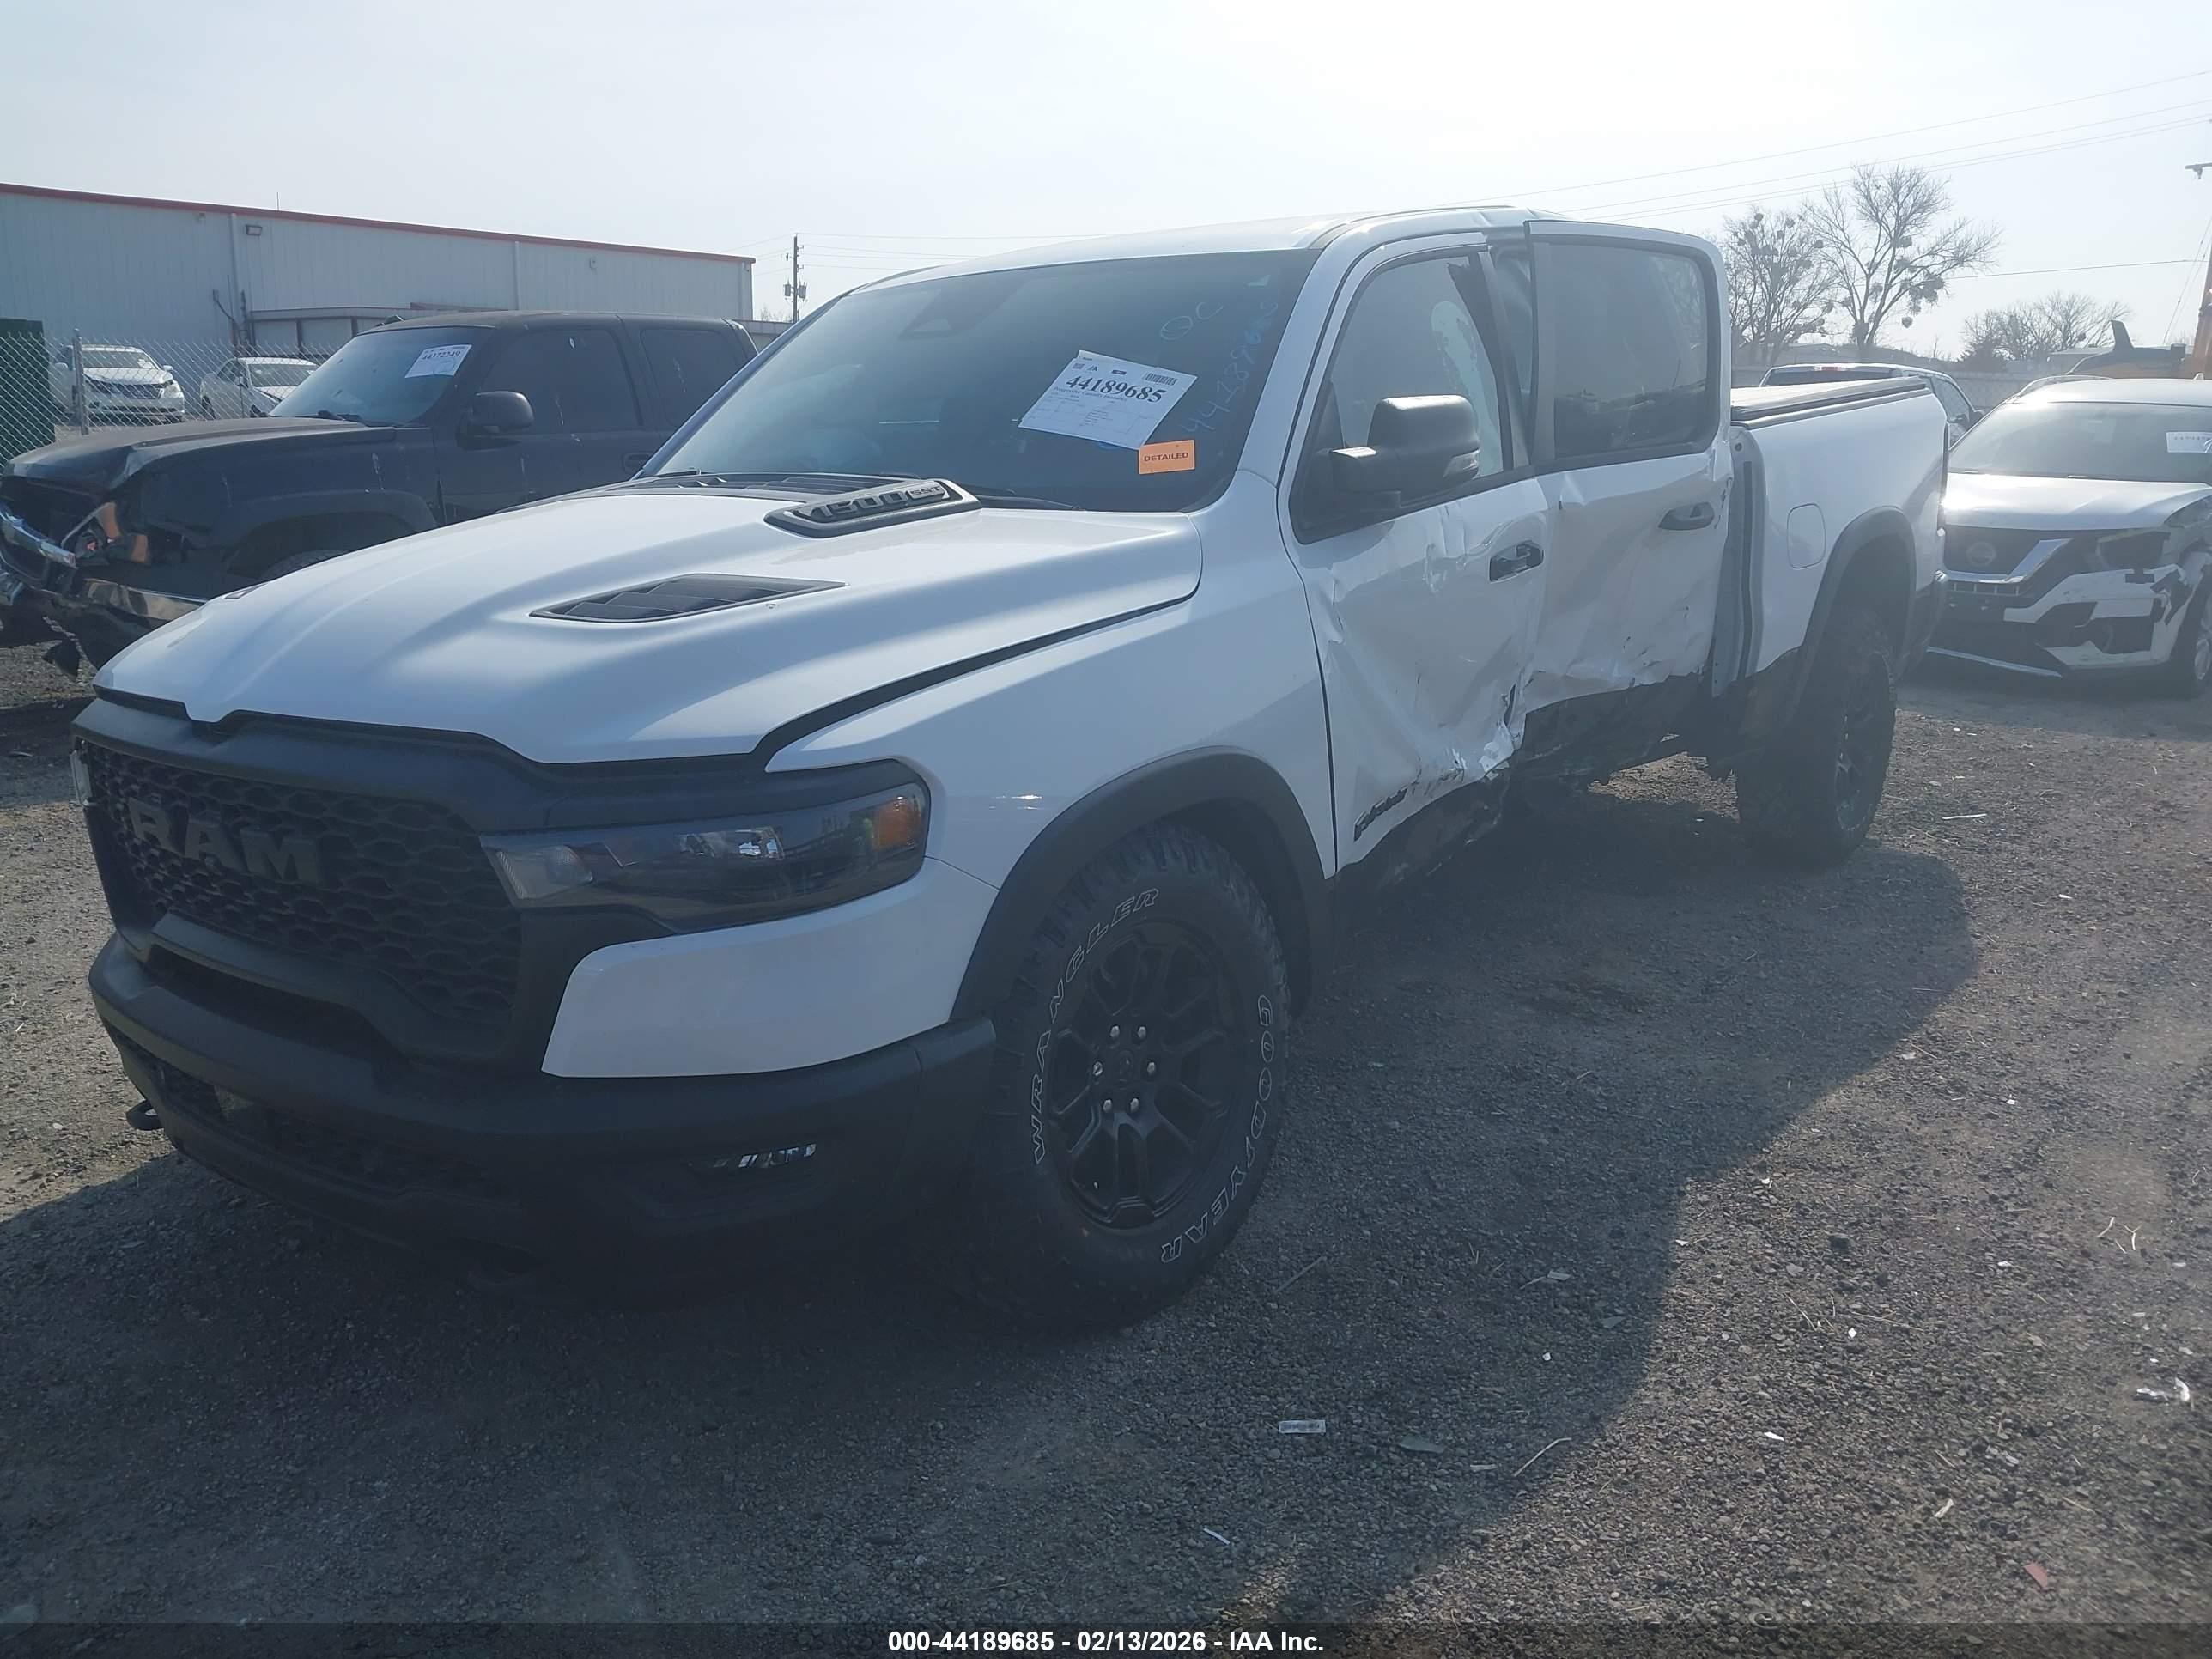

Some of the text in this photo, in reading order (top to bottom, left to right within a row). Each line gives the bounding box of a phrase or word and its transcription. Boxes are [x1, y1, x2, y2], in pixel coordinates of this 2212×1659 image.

[1066, 374, 1167, 403] 44189685
[1144, 451, 1189, 463] DETAILED
[128, 797, 321, 883] RAM
[1031, 888, 1160, 1165] WRANGLER
[1160, 994, 1274, 1264] GOODYEAR
